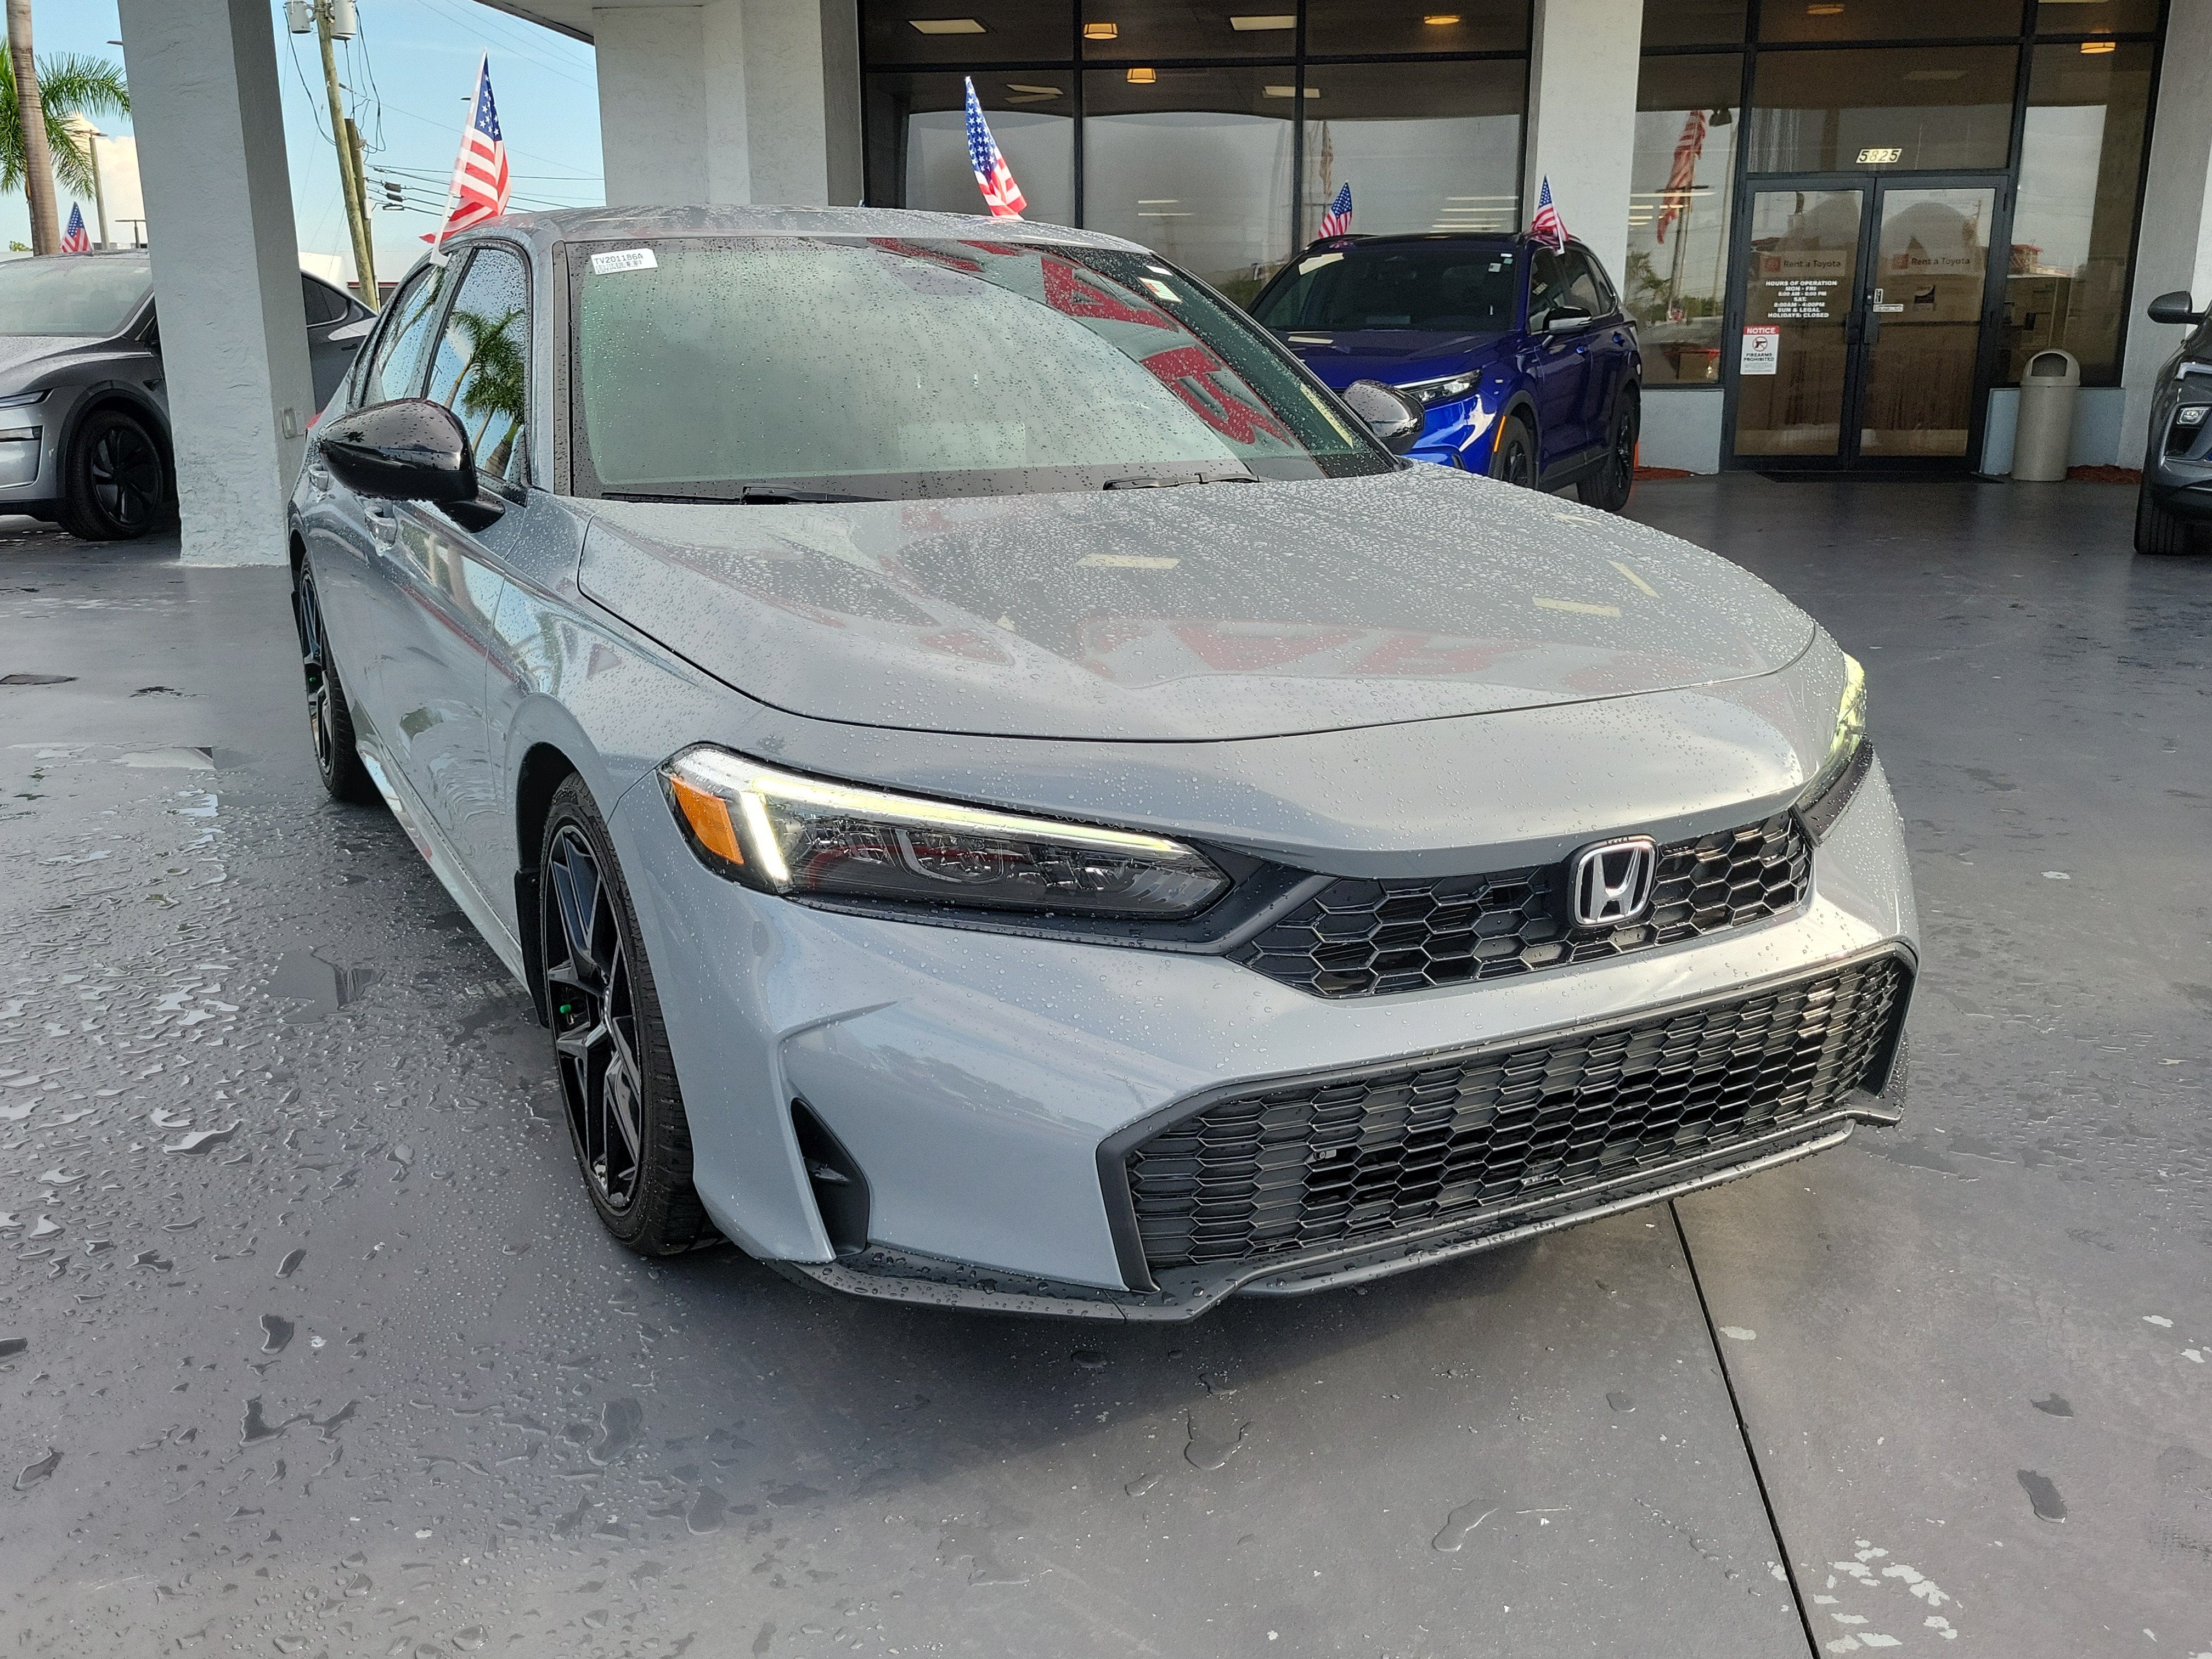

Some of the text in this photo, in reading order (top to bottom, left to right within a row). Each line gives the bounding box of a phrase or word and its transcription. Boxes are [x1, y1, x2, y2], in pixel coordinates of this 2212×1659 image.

[1859, 150, 1900, 162] 5825
[593, 253, 644, 265] TV201186A
[1784, 259, 1803, 268] Rent
[1813, 259, 1841, 269] Toyota
[1941, 258, 1971, 267] Toyota
